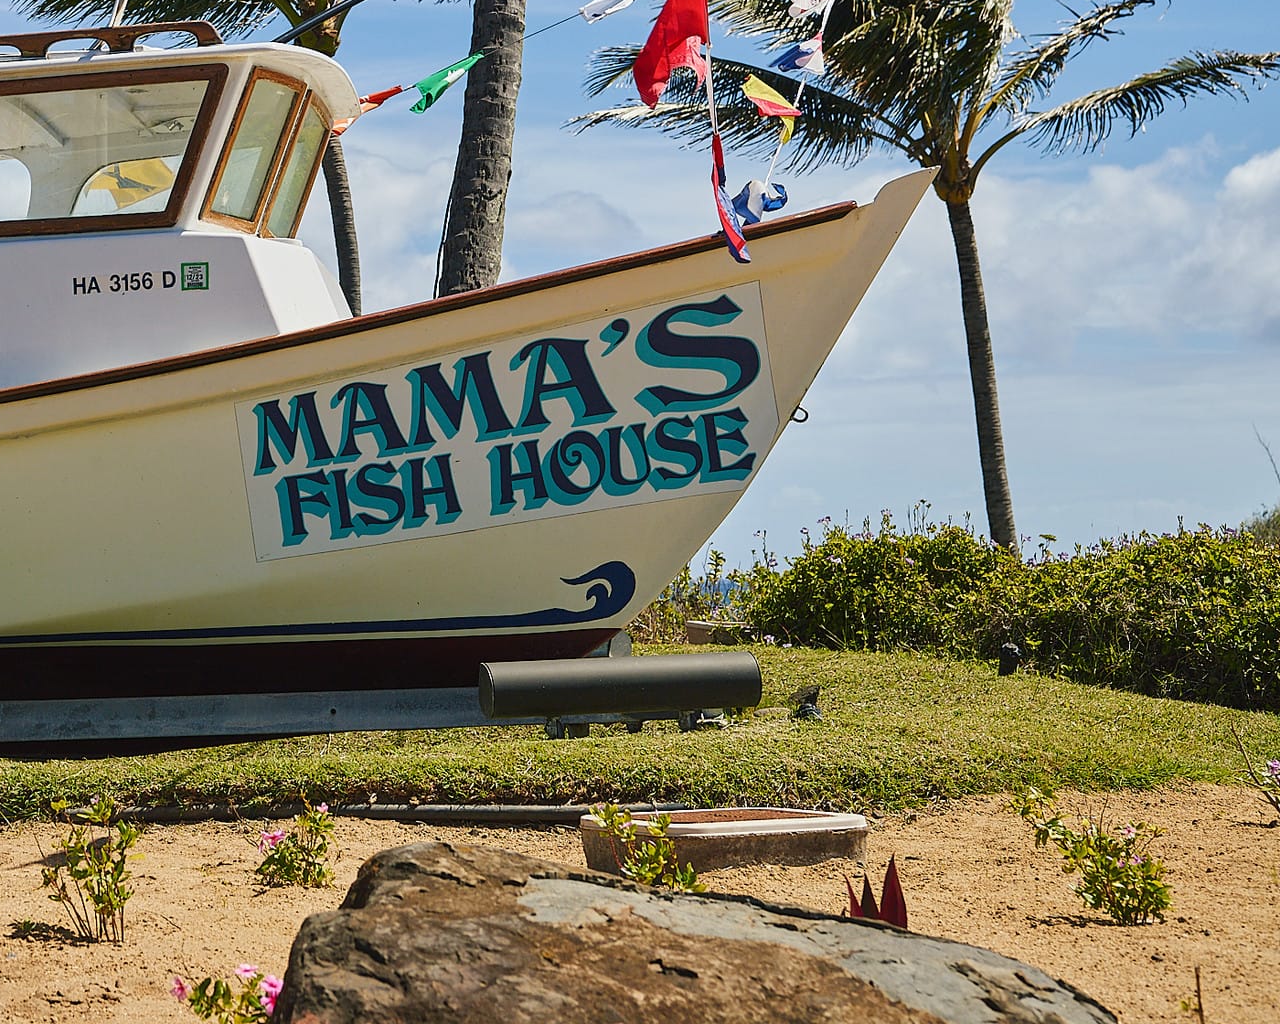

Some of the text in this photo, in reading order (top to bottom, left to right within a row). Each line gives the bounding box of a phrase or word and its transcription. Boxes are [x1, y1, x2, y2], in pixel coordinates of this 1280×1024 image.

[73, 271, 177, 295] HA 3156 D
[253, 294, 761, 476] MAMA'S
[275, 407, 758, 547] FISH HOUSE
